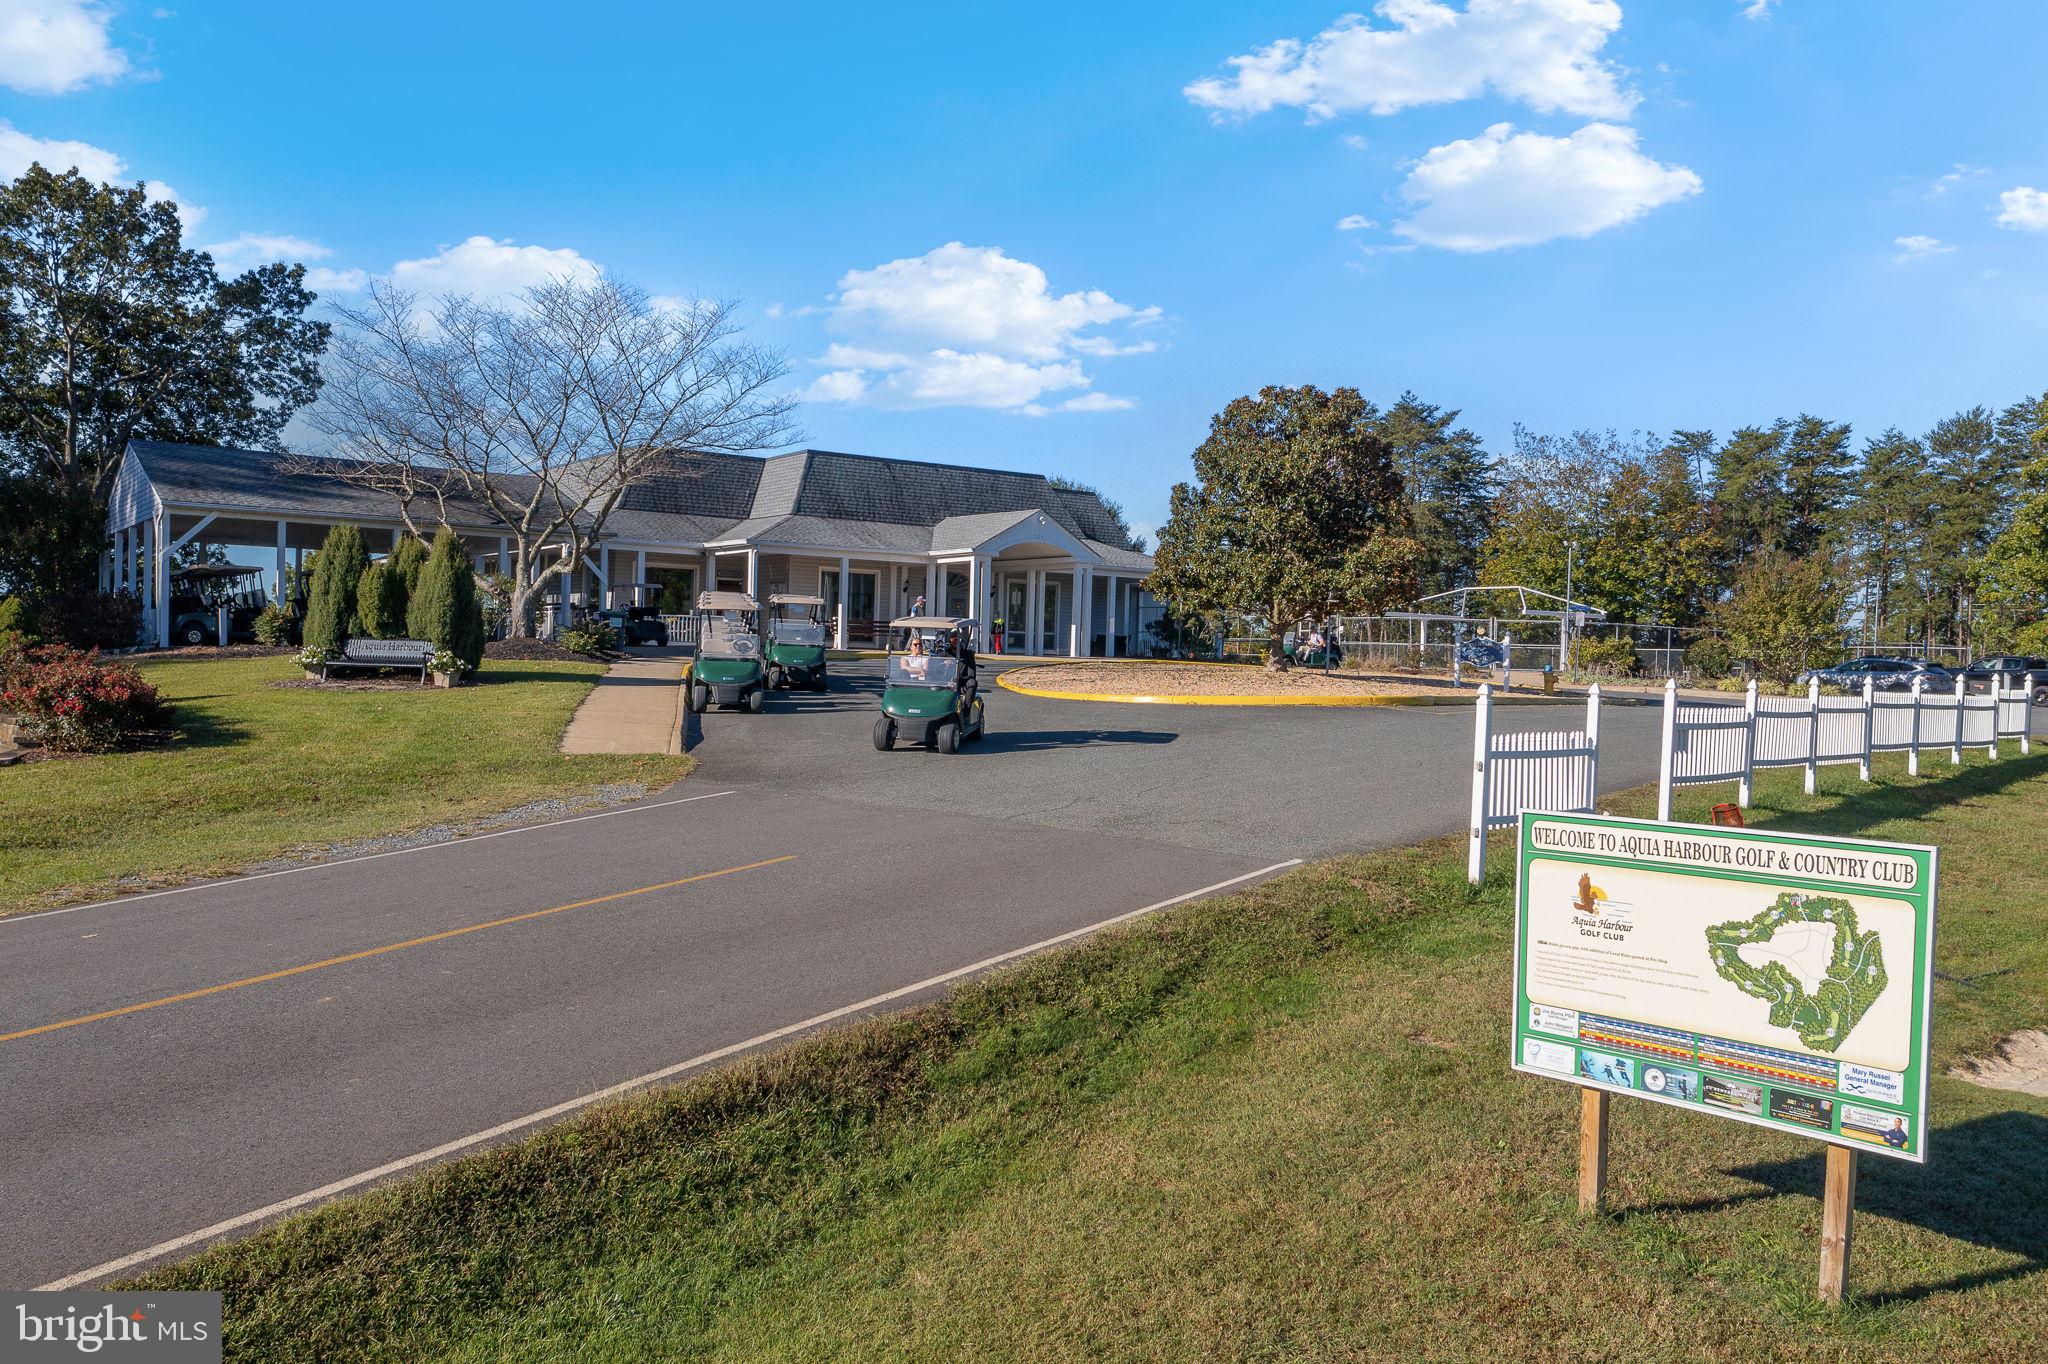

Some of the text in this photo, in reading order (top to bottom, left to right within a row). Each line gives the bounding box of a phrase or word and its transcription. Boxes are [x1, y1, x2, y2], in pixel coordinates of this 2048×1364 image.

[362, 642, 425, 652] Aquia Harbour
[1534, 827, 1914, 884] WELCOME TO AQUIA HARBOUR GOLF & COUNTRY CLUB
[1571, 916, 1633, 932] Aquia Harbour
[1580, 929, 1624, 942] GOLF CLUB
[1852, 1067, 1868, 1078] Mary
[1845, 1073, 1897, 1091] General Manager
